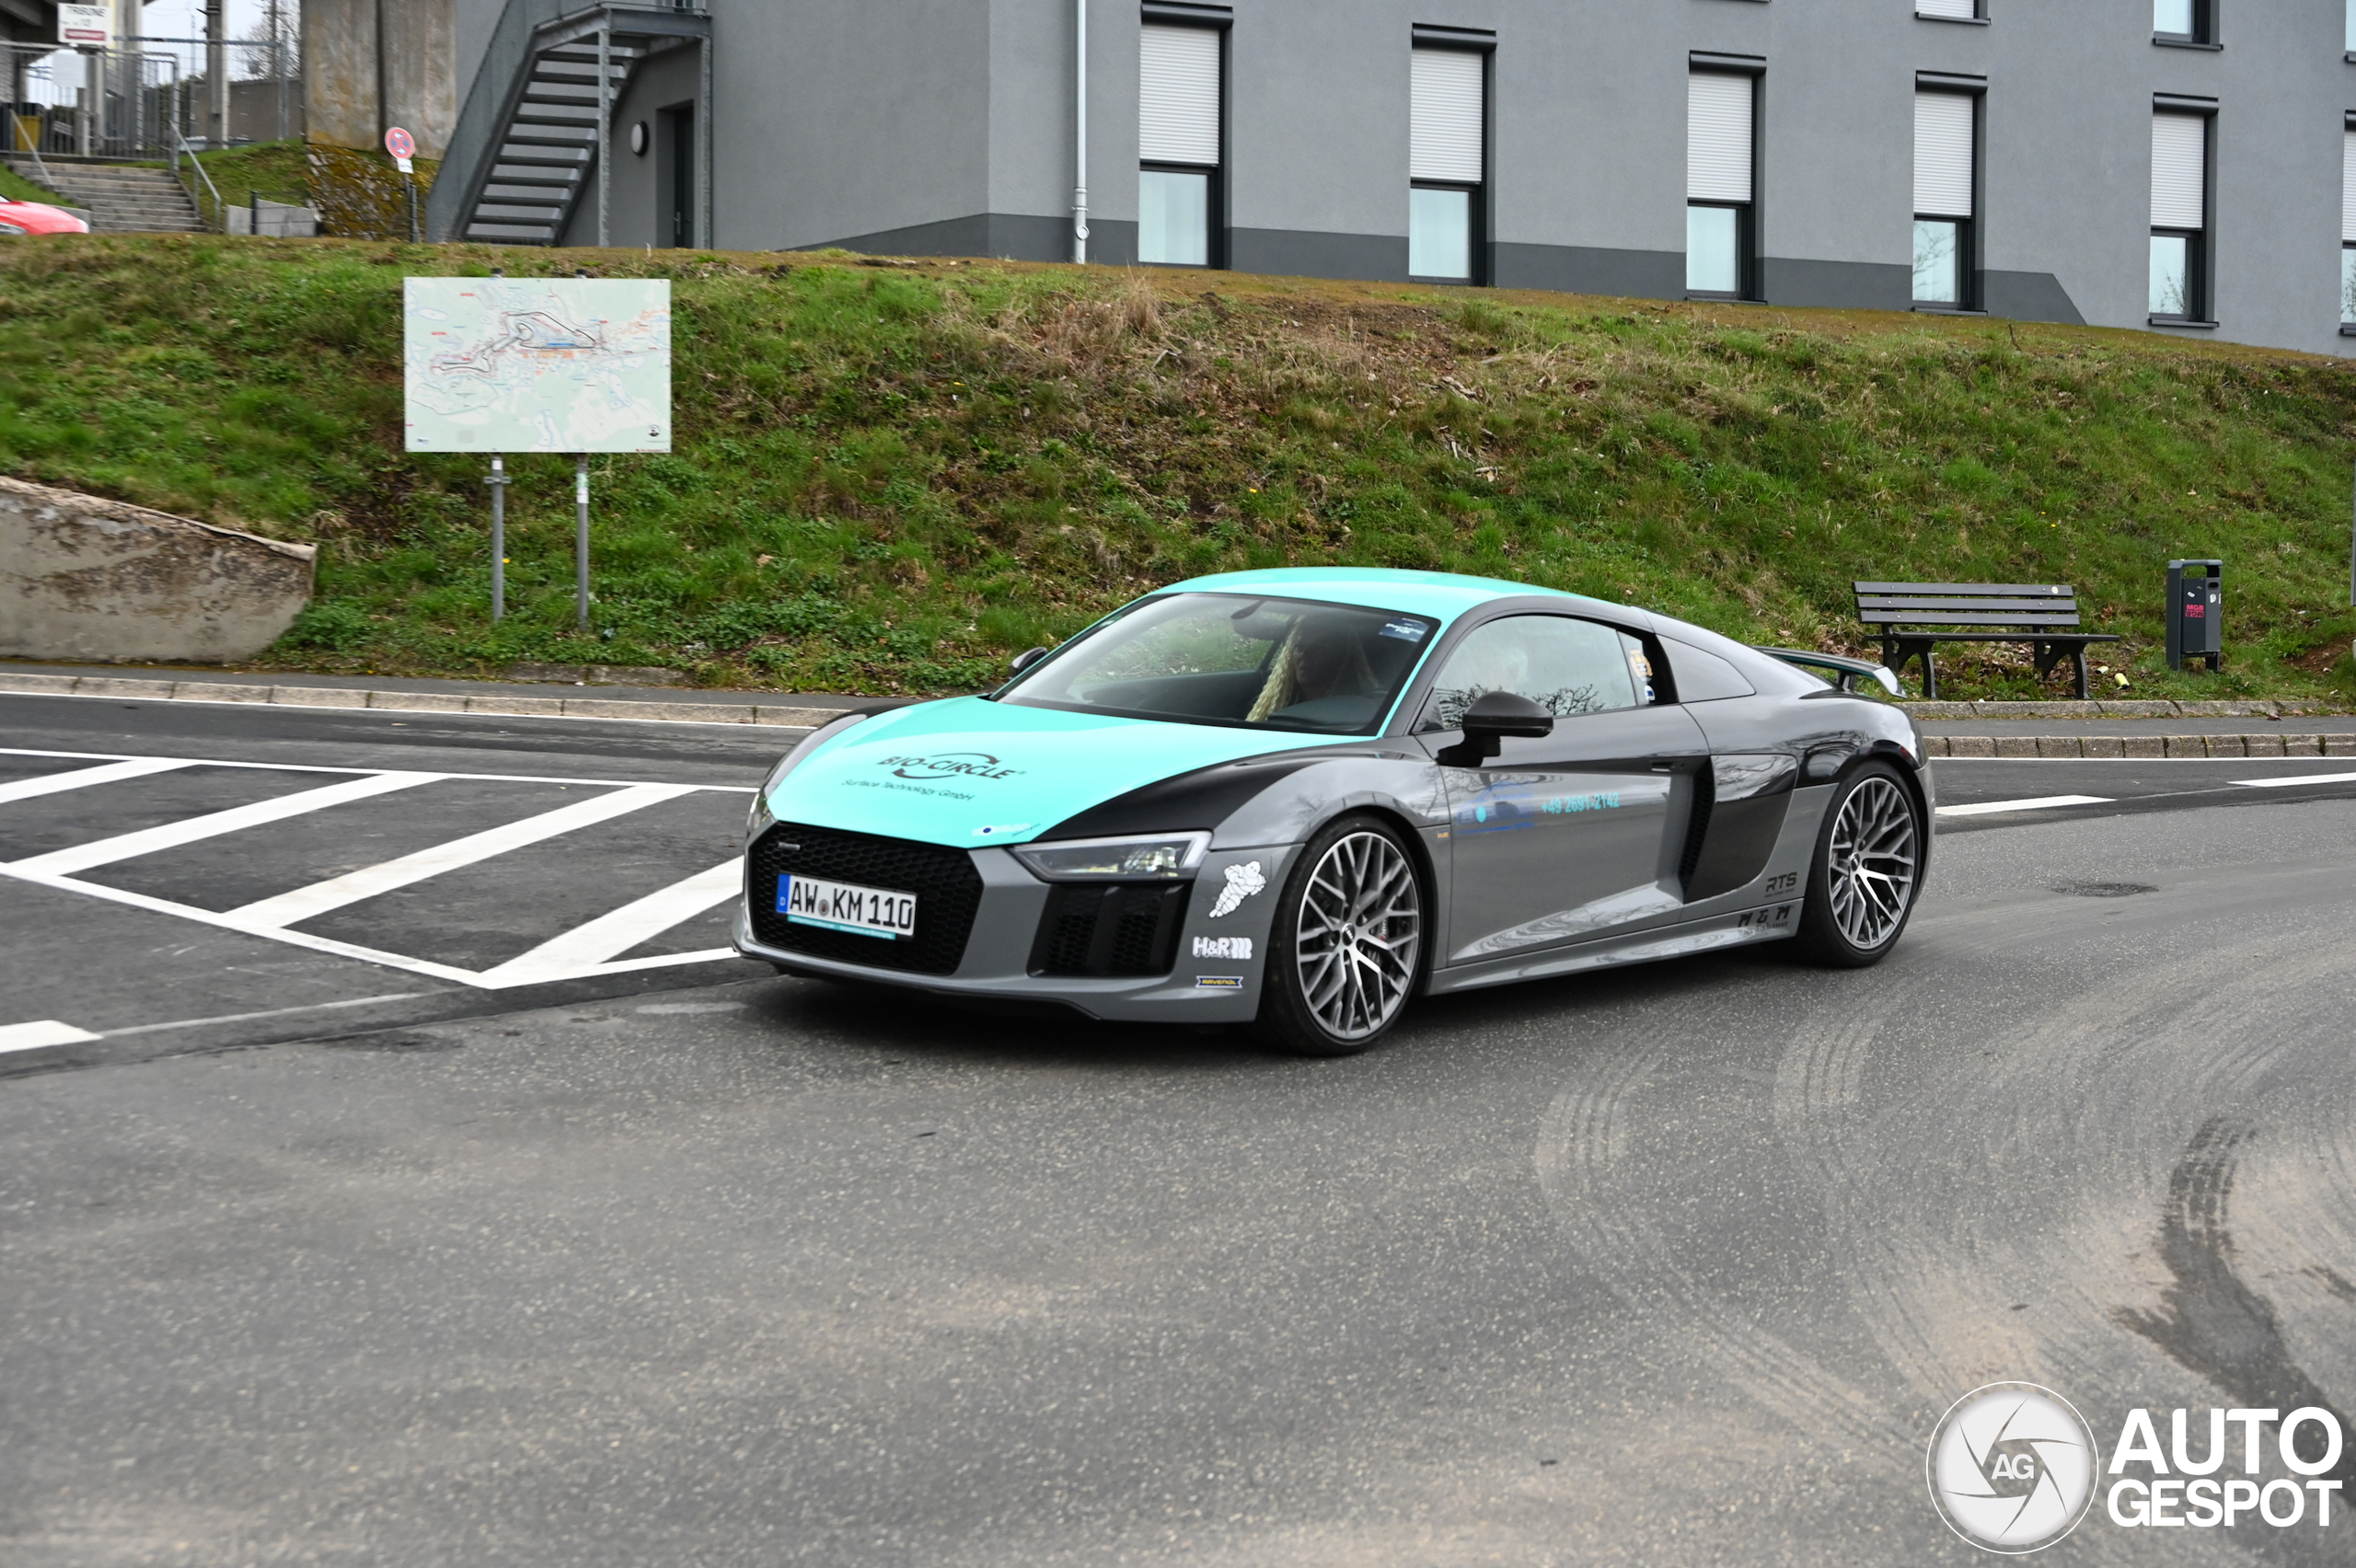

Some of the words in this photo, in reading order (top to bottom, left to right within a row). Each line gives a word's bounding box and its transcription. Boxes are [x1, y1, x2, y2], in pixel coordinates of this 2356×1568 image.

[877, 755, 1016, 779] BIO-CIRCLE
[841, 779, 881, 789] Surface
[882, 780, 938, 797] Technology
[938, 789, 976, 801] GmbH
[1542, 797, 1563, 814] +49
[1765, 871, 1797, 893] RTS
[790, 881, 819, 914] AW
[832, 887, 863, 922] KM
[868, 894, 913, 930] 110
[1193, 936, 1242, 959] H&R
